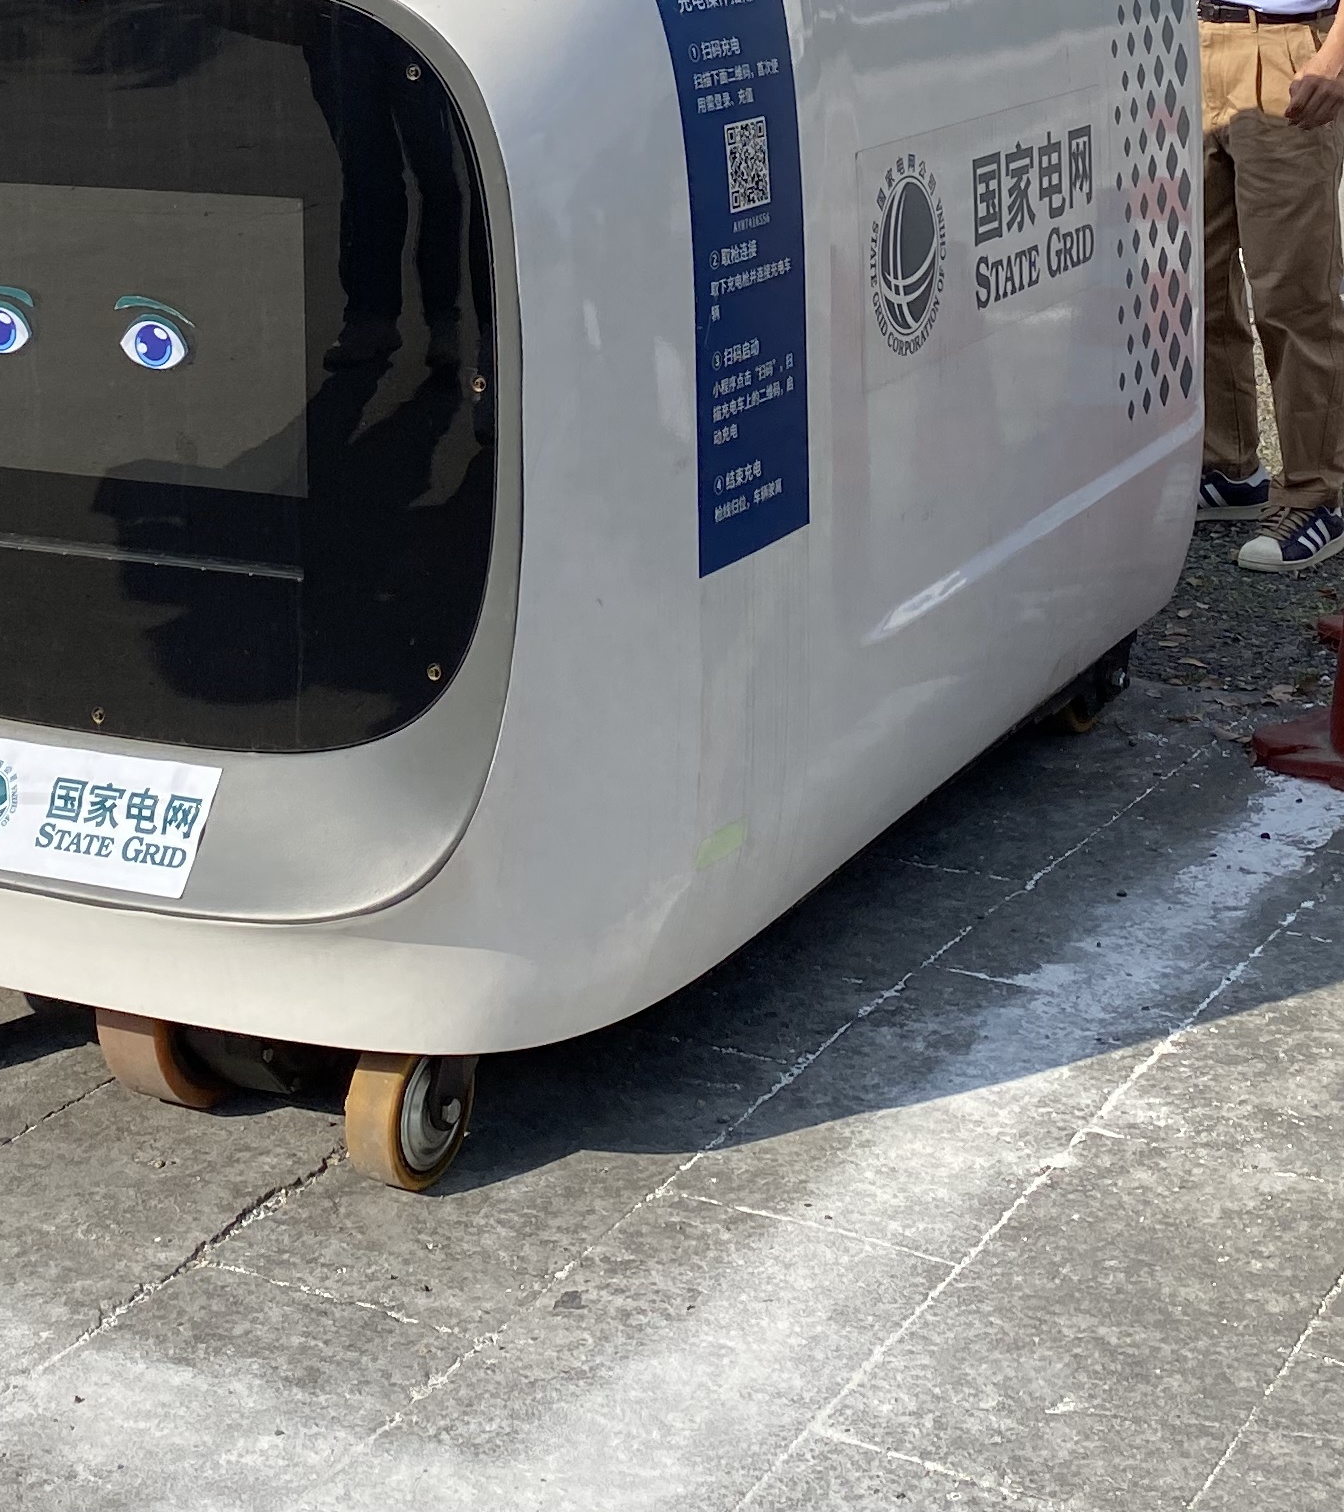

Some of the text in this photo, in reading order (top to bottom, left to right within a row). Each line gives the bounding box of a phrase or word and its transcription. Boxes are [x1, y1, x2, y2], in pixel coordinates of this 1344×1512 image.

[972, 124, 1094, 247] 国家电网
[870, 220, 879, 288] STATE
[975, 223, 1095, 311] STATE GRID
[872, 292, 889, 337] GRID
[887, 294, 940, 357] CORPORATION
[46, 776, 203, 840] 国家电网
[35, 822, 188, 869] STATE GRID
